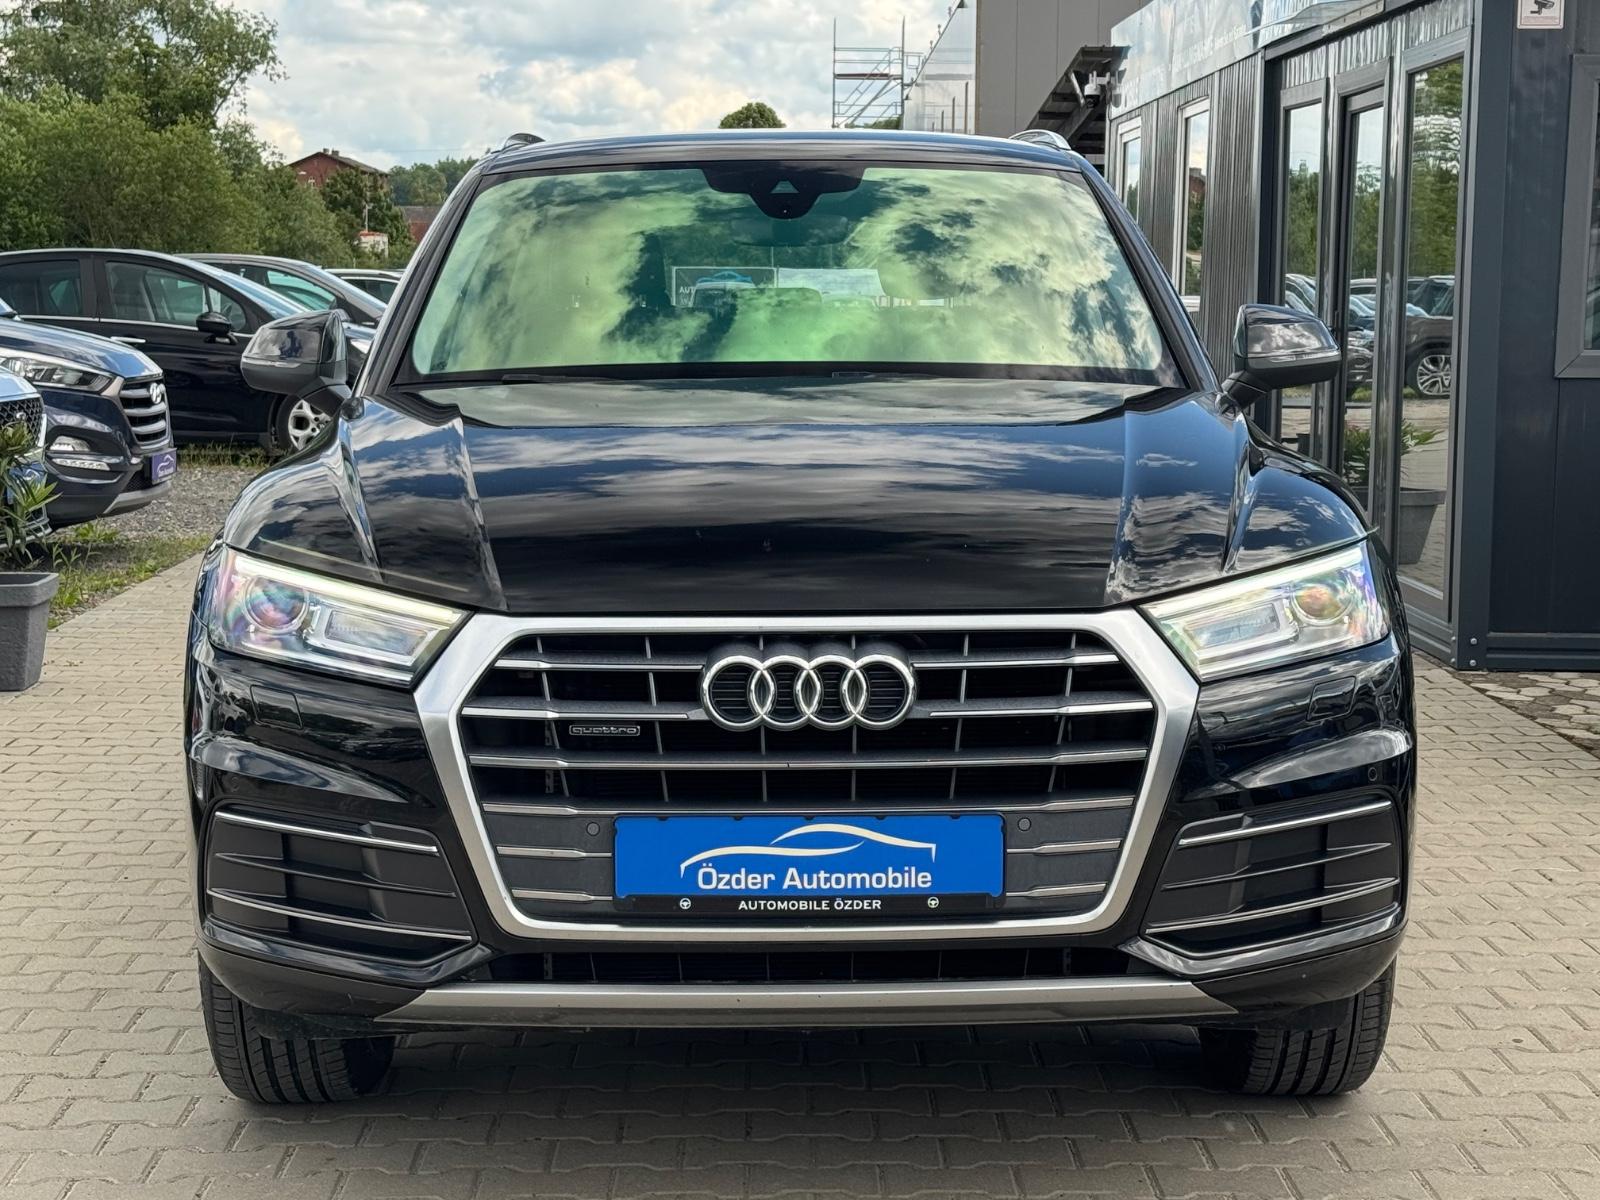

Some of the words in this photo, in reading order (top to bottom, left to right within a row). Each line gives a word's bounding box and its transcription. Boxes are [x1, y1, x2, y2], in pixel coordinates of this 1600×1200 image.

[572, 727, 637, 735] quattro
[697, 862, 776, 890] Özder
[782, 866, 932, 890] Automobile
[738, 900, 830, 911] AUTOMOBILE
[834, 897, 882, 911] ÖZDER
